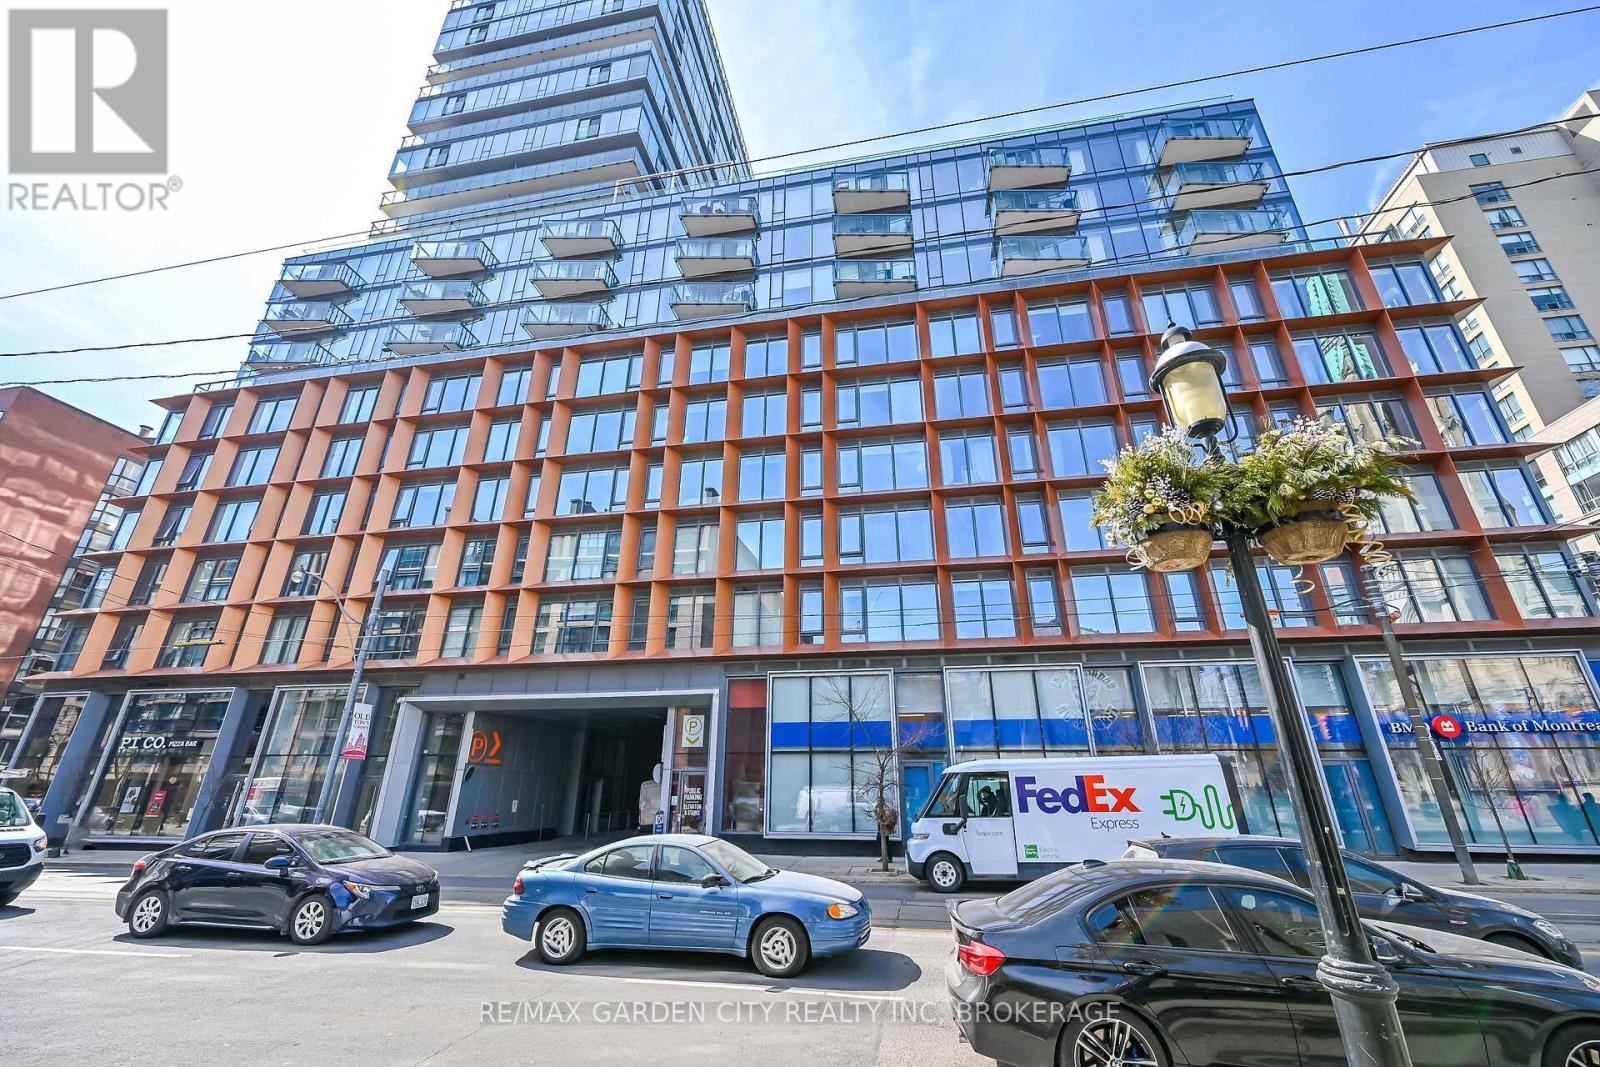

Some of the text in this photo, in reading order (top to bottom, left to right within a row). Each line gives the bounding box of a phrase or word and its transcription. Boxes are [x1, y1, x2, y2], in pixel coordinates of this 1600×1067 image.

[354, 712, 370, 720] OLD
[1390, 719, 1600, 734] BM Bank of Montrea
[118, 737, 142, 749] PI
[143, 736, 167, 749] CO.
[683, 793, 703, 801] PARKING
[1014, 774, 1143, 814] FedEx
[1090, 817, 1140, 832] Express
